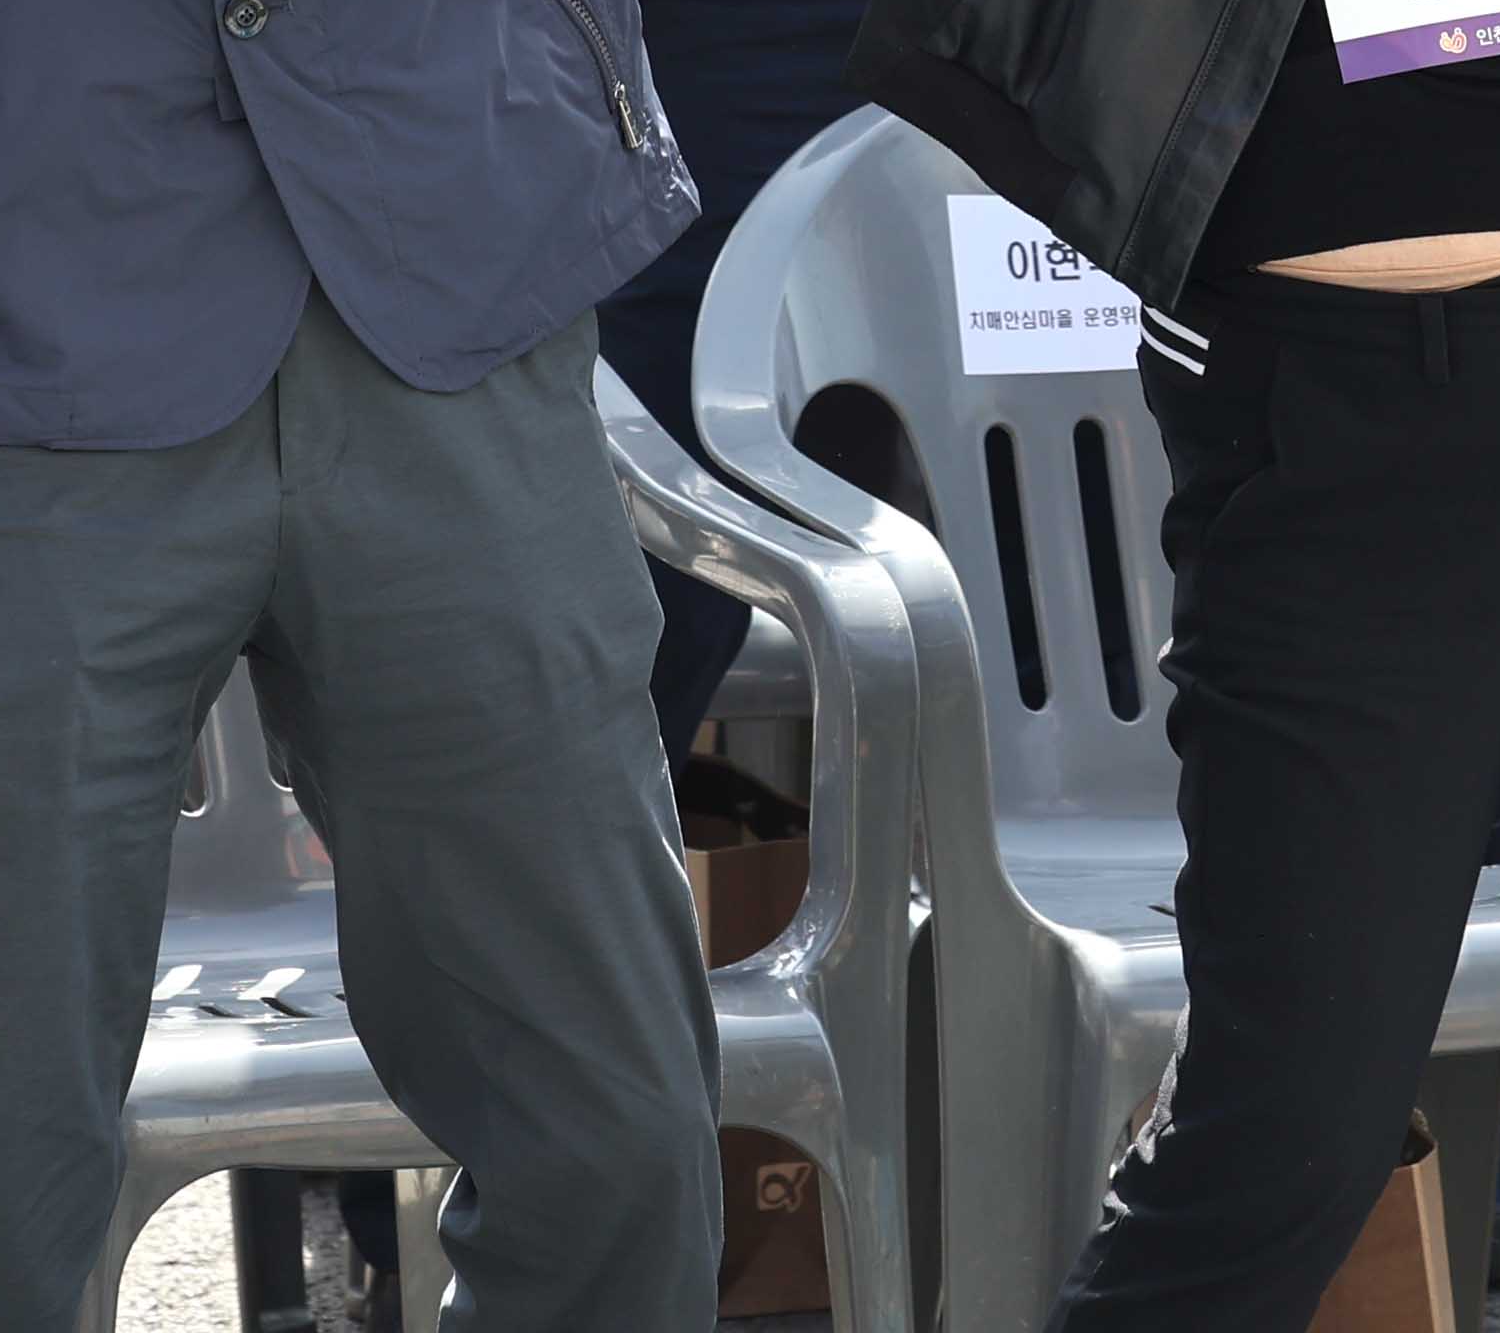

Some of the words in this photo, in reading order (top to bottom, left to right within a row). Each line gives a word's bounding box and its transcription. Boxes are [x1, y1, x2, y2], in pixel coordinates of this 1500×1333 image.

[1007, 239, 1098, 282] 이현
[969, 308, 1073, 332] 치매안심마을
[1083, 305, 1139, 328] 운영위
